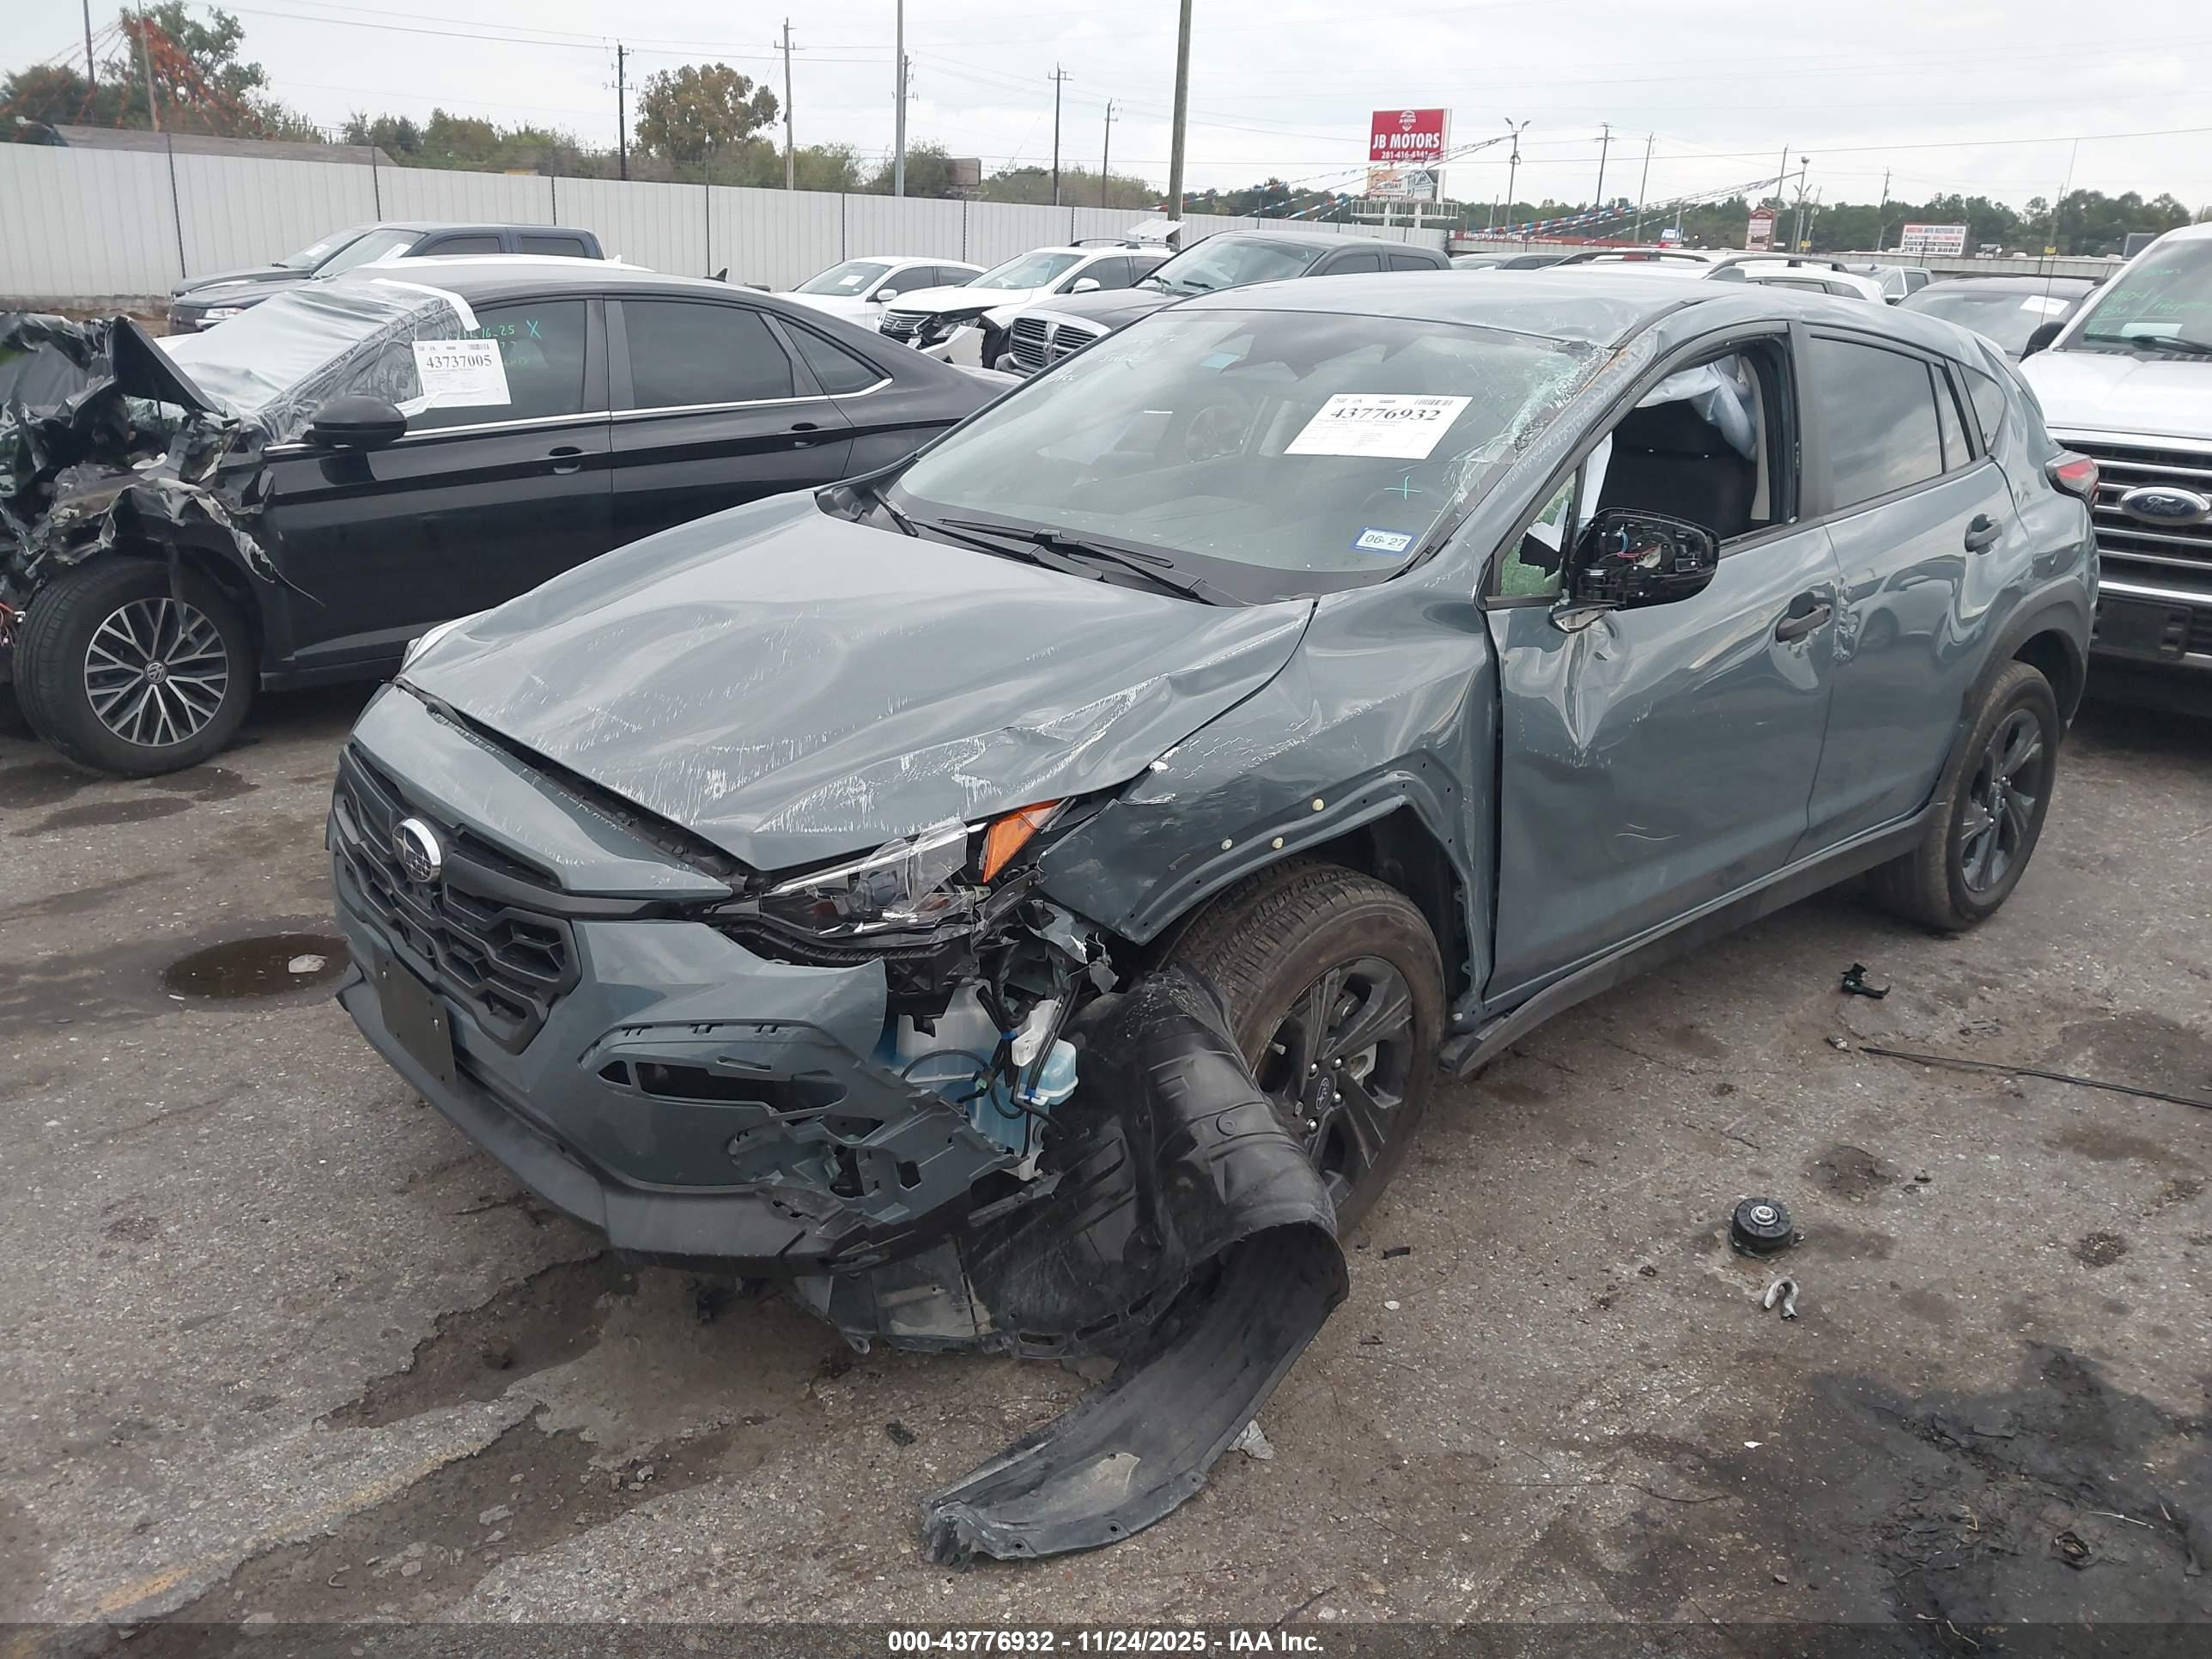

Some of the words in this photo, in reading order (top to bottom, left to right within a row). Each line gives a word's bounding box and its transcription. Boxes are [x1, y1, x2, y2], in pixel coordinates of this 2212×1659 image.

[1372, 134, 1387, 149] JB
[1389, 132, 1440, 149] MOTORS
[427, 355, 492, 368] 43737005
[1330, 408, 1441, 421] 43776932
[2144, 495, 2185, 514] Ford
[1366, 535, 1382, 544] 06
